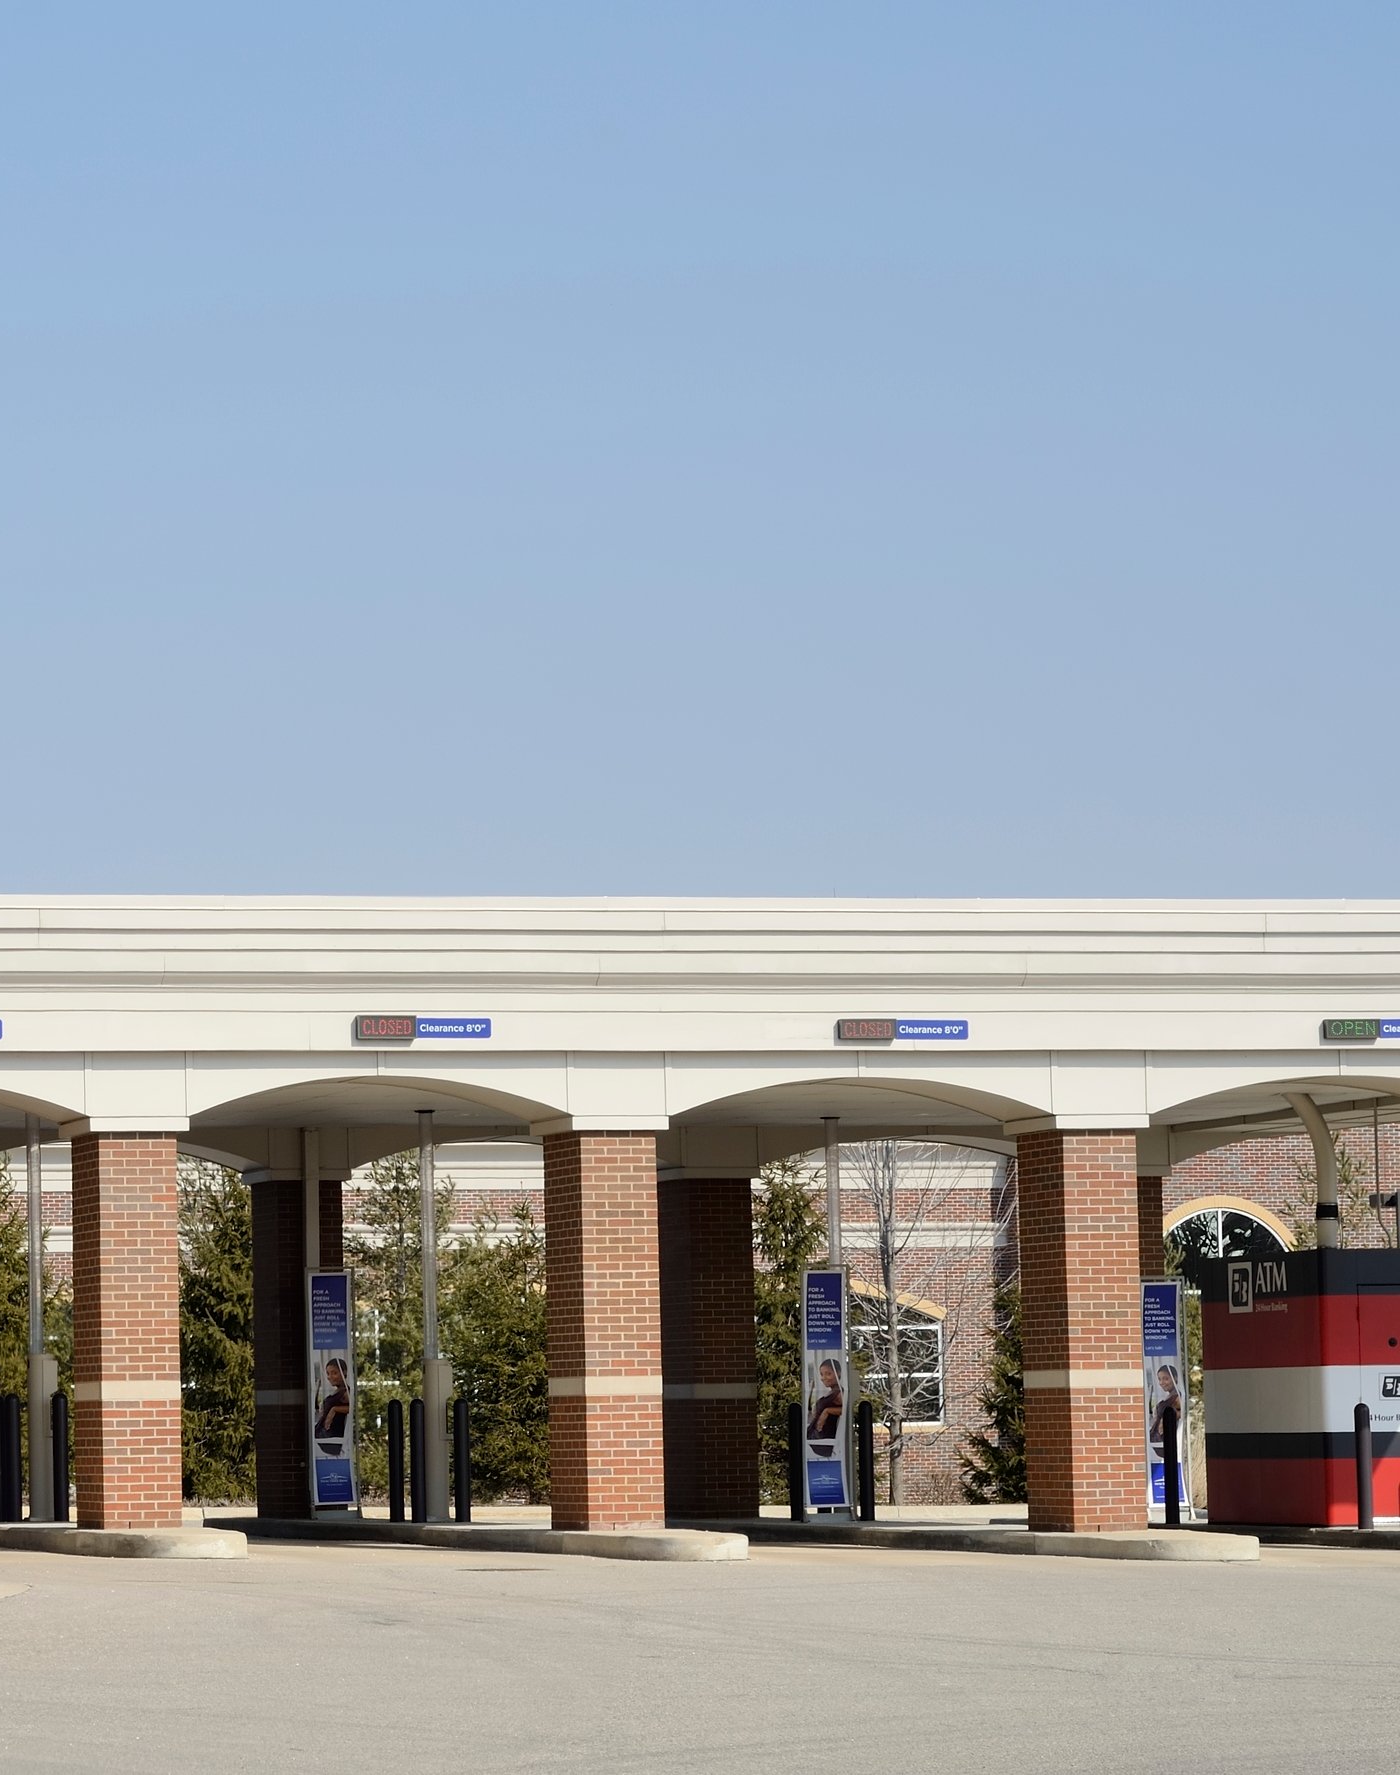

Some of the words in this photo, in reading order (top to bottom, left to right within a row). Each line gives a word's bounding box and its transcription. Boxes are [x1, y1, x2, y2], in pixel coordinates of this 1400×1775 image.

[362, 1018, 412, 1035] CLOSED
[420, 1024, 465, 1033] Clearance
[844, 1022, 892, 1037] CLOSED
[899, 1025, 942, 1034] Clearance
[1331, 1021, 1376, 1036] OPEN
[1255, 1261, 1287, 1293] ATM
